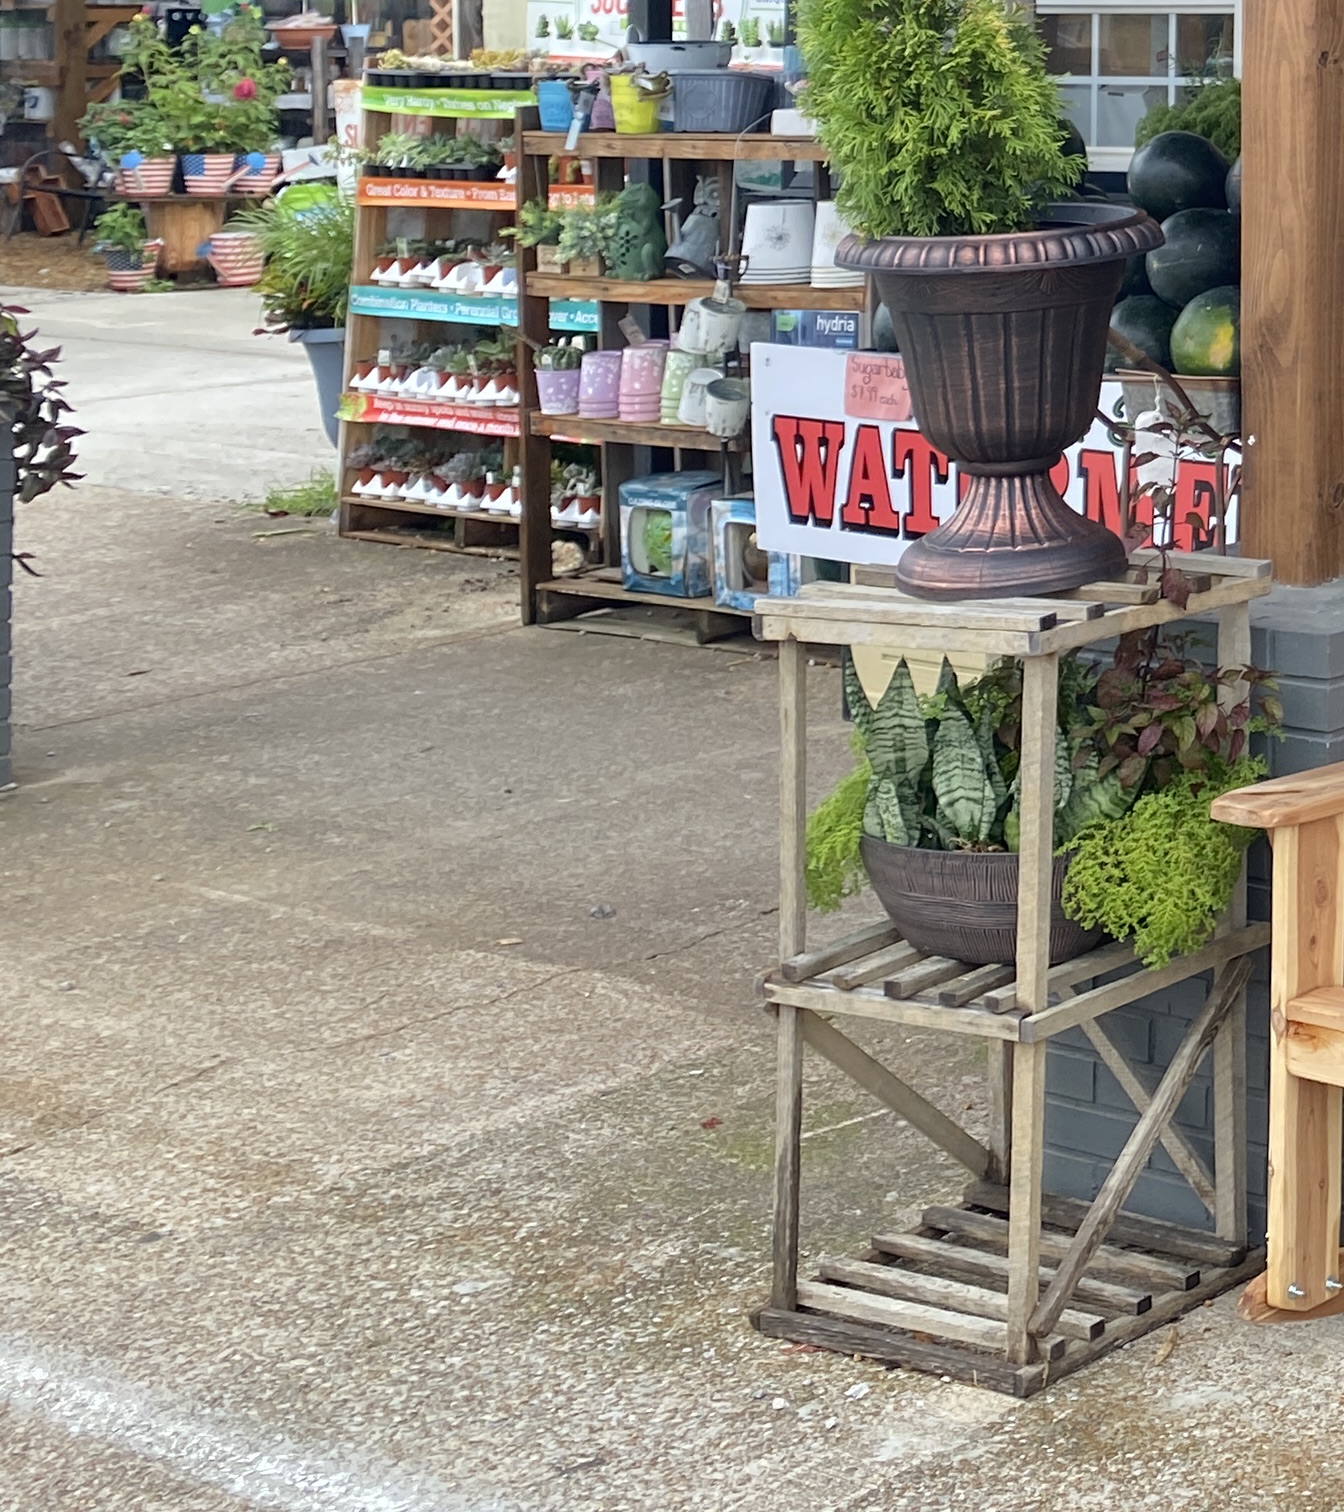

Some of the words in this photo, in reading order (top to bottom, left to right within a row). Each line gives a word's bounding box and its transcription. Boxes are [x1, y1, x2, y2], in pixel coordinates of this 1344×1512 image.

[393, 184, 418, 197] Color
[816, 314, 854, 335] hydria
[850, 355, 905, 385] Sugarbab
